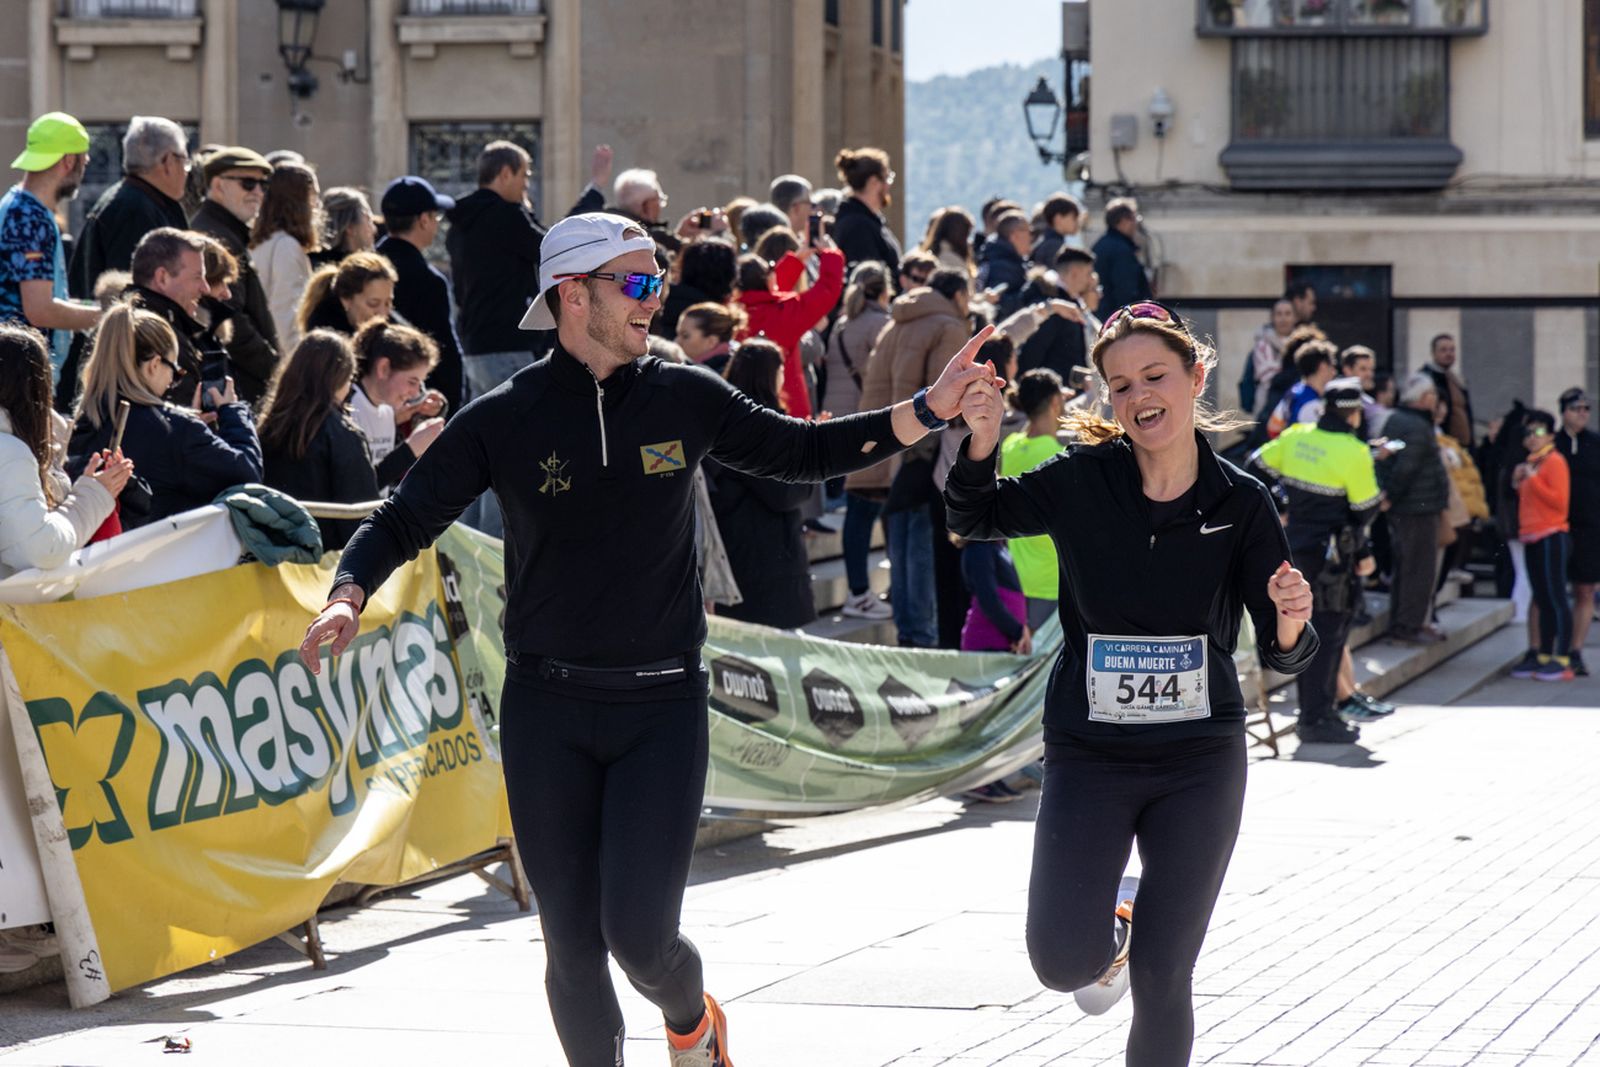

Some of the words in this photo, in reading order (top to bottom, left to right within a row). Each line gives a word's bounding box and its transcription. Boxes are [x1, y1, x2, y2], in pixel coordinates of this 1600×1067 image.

[1105, 644, 1113, 652] VI
[1115, 644, 1151, 653] CARRERA
[1153, 643, 1192, 654] CAMINATA
[1105, 655, 1135, 669] BUENA
[1138, 656, 1176, 670] MUERTE
[722, 669, 768, 702] ownat
[1116, 674, 1181, 705] 544
